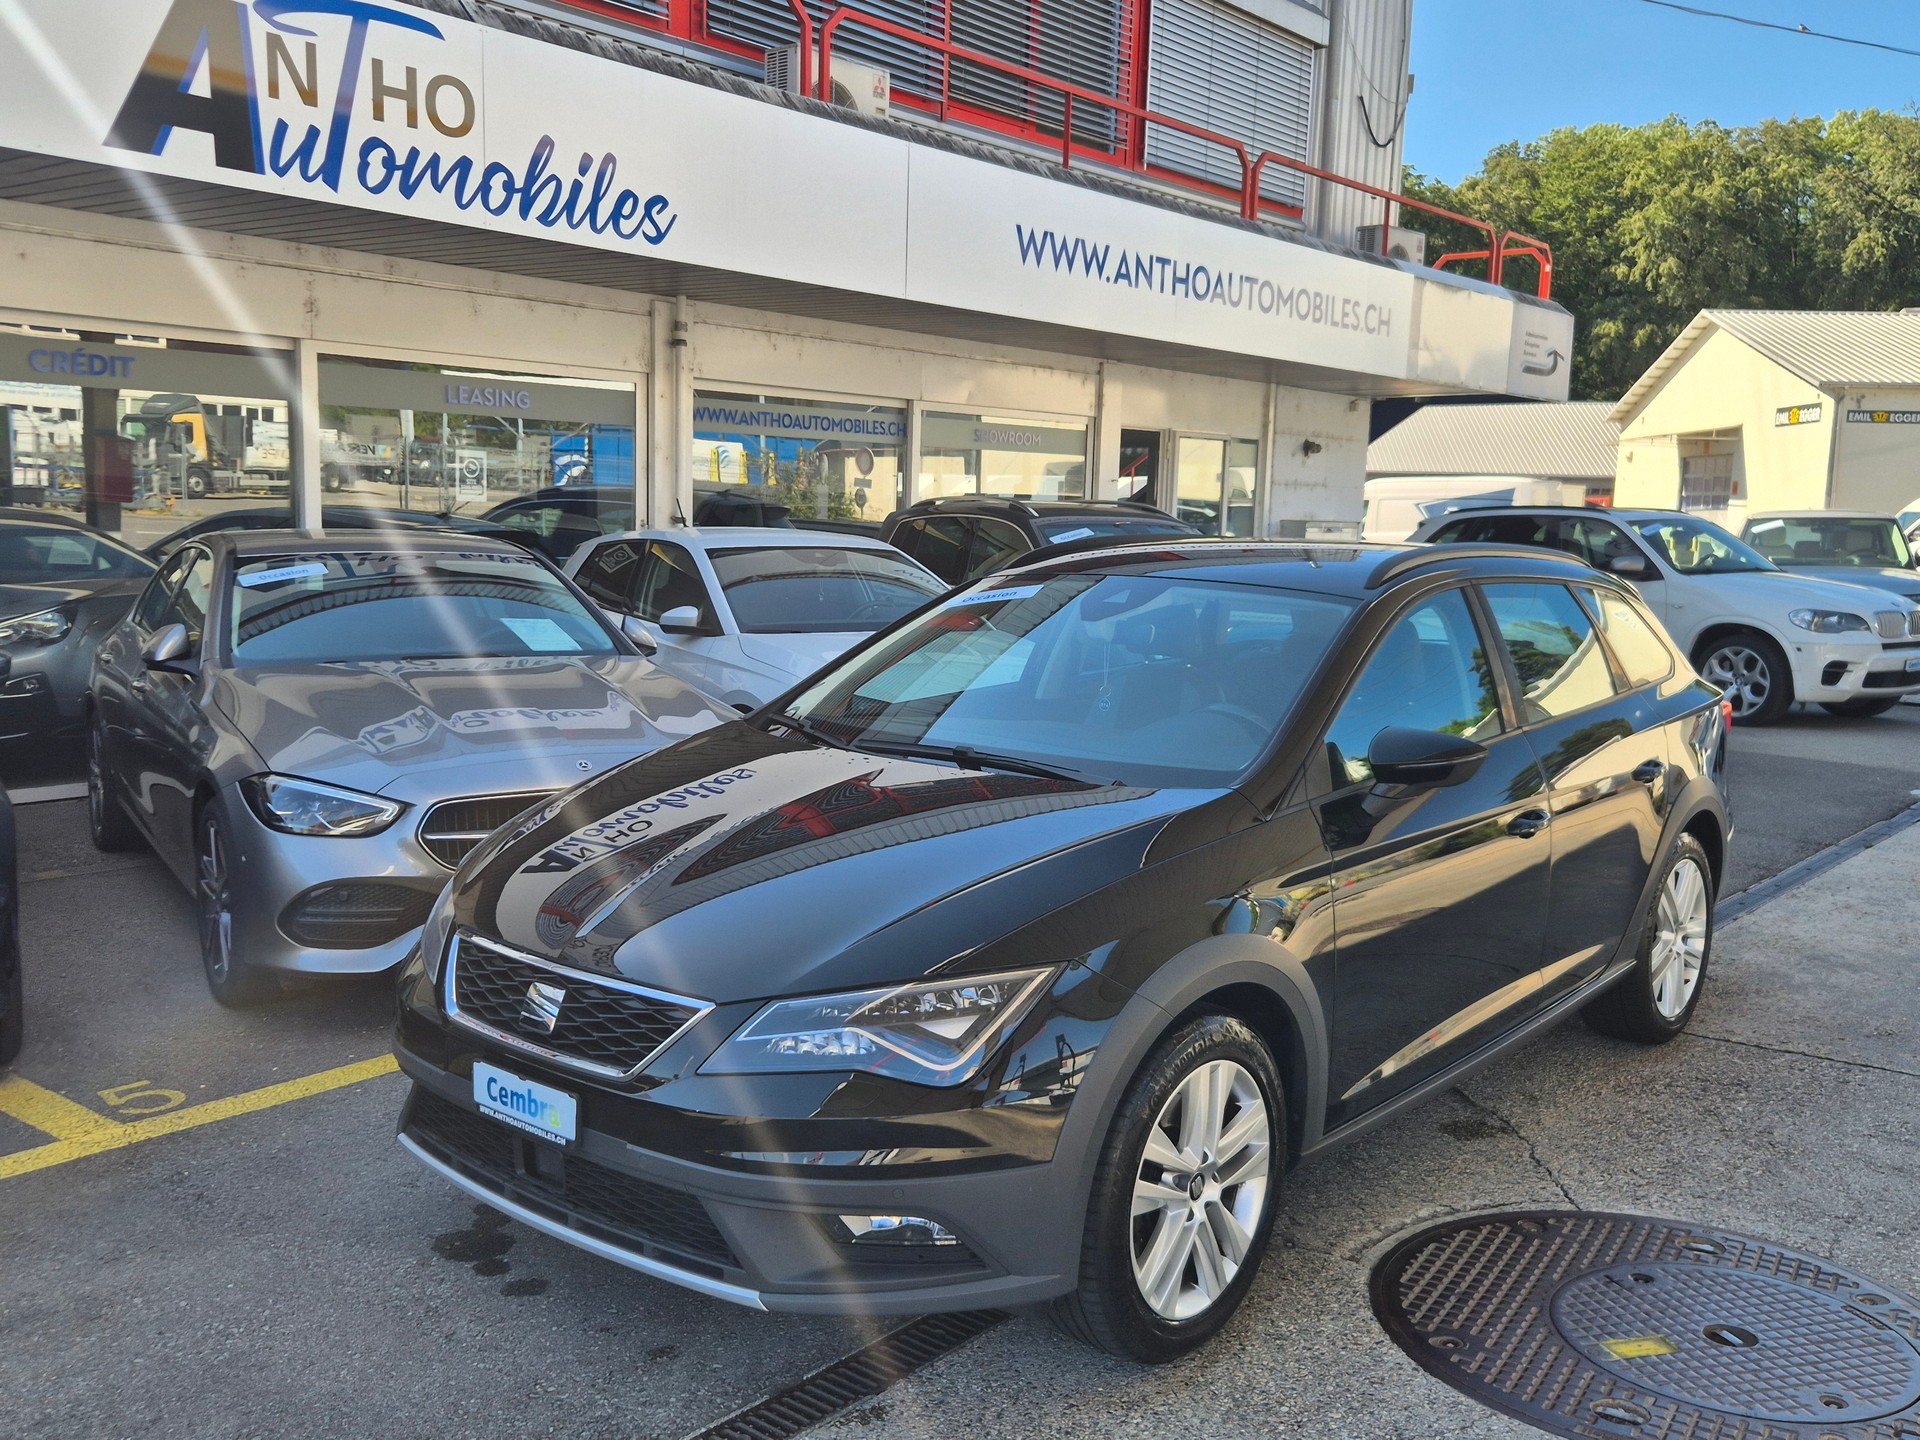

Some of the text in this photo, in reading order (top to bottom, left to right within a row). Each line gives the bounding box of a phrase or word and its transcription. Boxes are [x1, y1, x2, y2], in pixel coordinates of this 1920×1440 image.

[103, 0, 475, 193] ANTHO
[1015, 224, 1392, 338] WWW.ANTHOAUTOMOBILES.CH
[29, 347, 136, 379] CRÉDIT
[446, 384, 532, 410] LEASING
[693, 408, 907, 438] WWW.ANTHOAUTOMOBILES.CH
[1848, 411, 1872, 422] EMIL
[974, 428, 1041, 446] SHOWROOM
[259, 567, 309, 581] Occasion
[962, 590, 1018, 603] Occasion
[97, 1079, 188, 1114] 5
[486, 1076, 561, 1127] Cembra
